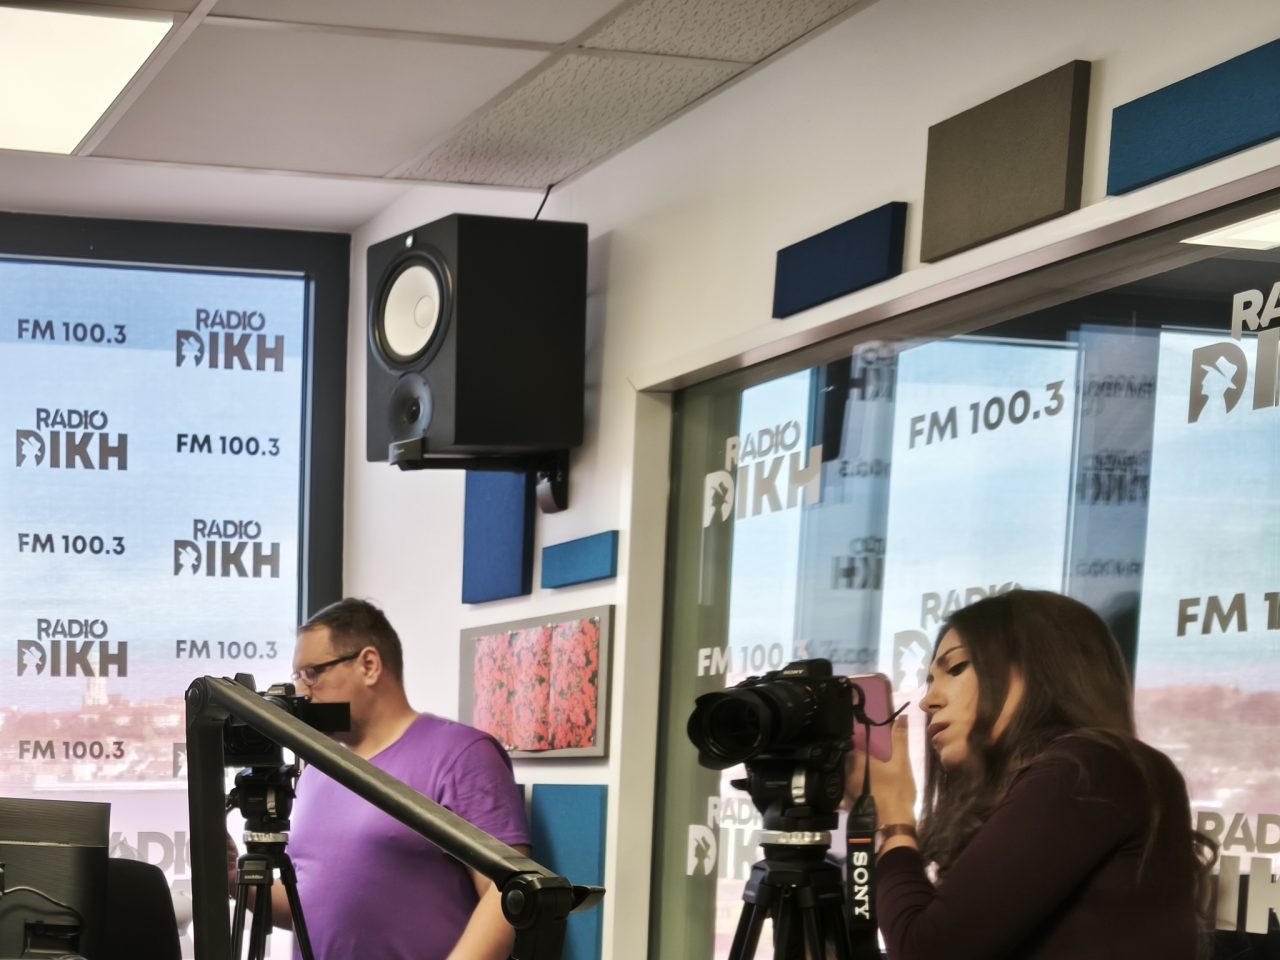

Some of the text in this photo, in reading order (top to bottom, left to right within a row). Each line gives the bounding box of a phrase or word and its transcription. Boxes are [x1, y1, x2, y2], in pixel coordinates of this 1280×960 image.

[17, 318, 127, 345] FM 100.3
[196, 308, 266, 332] RADIO
[35, 407, 108, 431] RADIO
[908, 406, 957, 450] FM
[970, 379, 1065, 434] 100.3
[176, 433, 281, 456] FM 100.3
[725, 420, 801, 472] RADIO
[193, 518, 261, 541] RADIO
[17, 533, 126, 555] FM 100.3
[1176, 592, 1248, 637] FM
[36, 618, 108, 640] RADIO
[175, 639, 279, 660] FM 100.3
[697, 646, 733, 677] FM
[18, 739, 126, 760] FM 100.3
[852, 851, 870, 920] SONY
